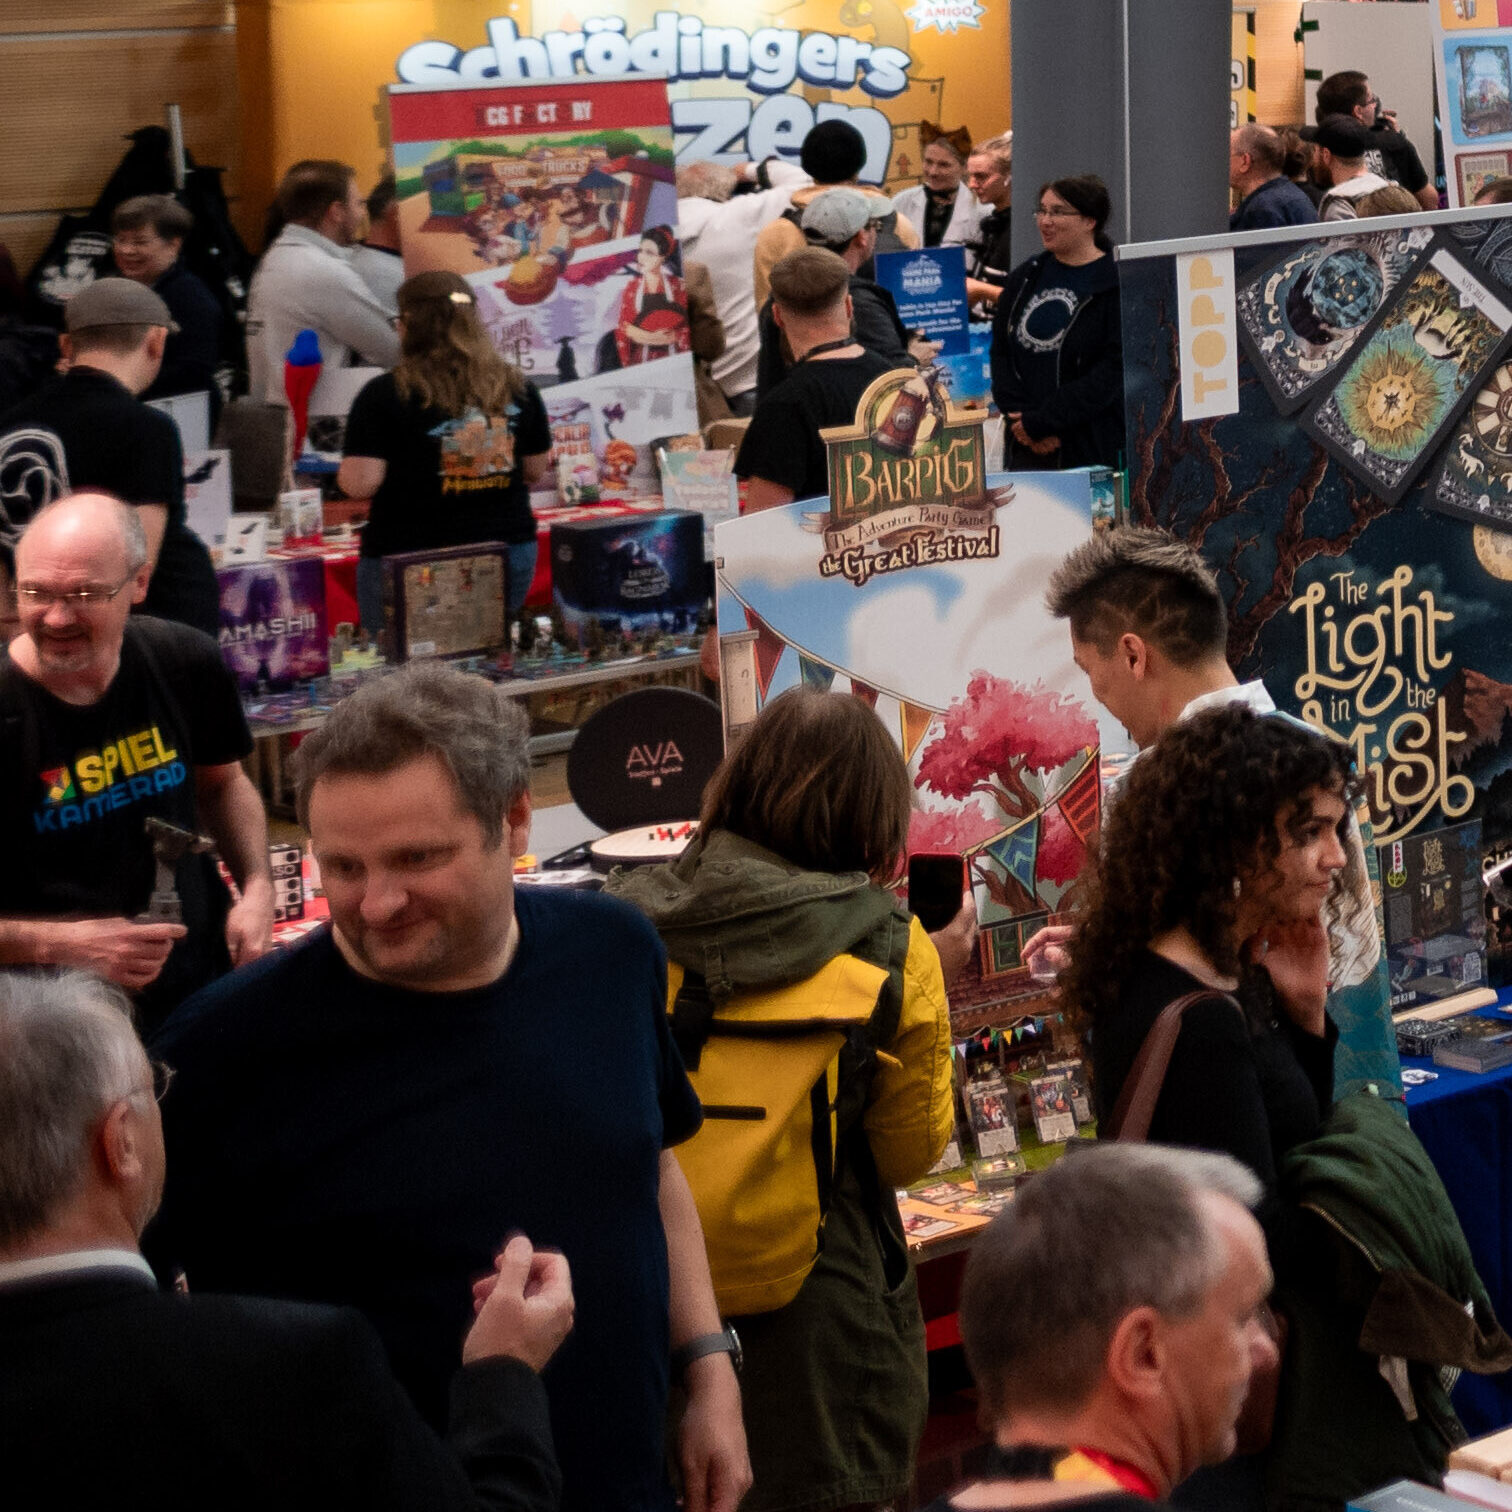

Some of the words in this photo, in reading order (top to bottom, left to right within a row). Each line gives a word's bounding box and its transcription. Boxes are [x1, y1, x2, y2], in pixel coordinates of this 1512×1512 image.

[924, 5, 974, 18] AMIGO
[397, 11, 912, 99] Schrödingers
[1189, 254, 1228, 405] TOPP
[843, 436, 975, 510] BARPIG
[821, 555, 842, 577] the
[842, 542, 914, 587] Great
[912, 525, 1000, 565] Festival
[857, 514, 916, 541] Adventure
[918, 507, 951, 527] Party
[952, 510, 987, 527] Game
[1330, 571, 1368, 605] The
[1289, 565, 1455, 717] Light
[1331, 695, 1350, 723] in
[1405, 678, 1436, 709] the
[75, 725, 179, 797] SPIEL
[626, 739, 684, 769] AVA
[33, 761, 188, 835] KAMERAD
